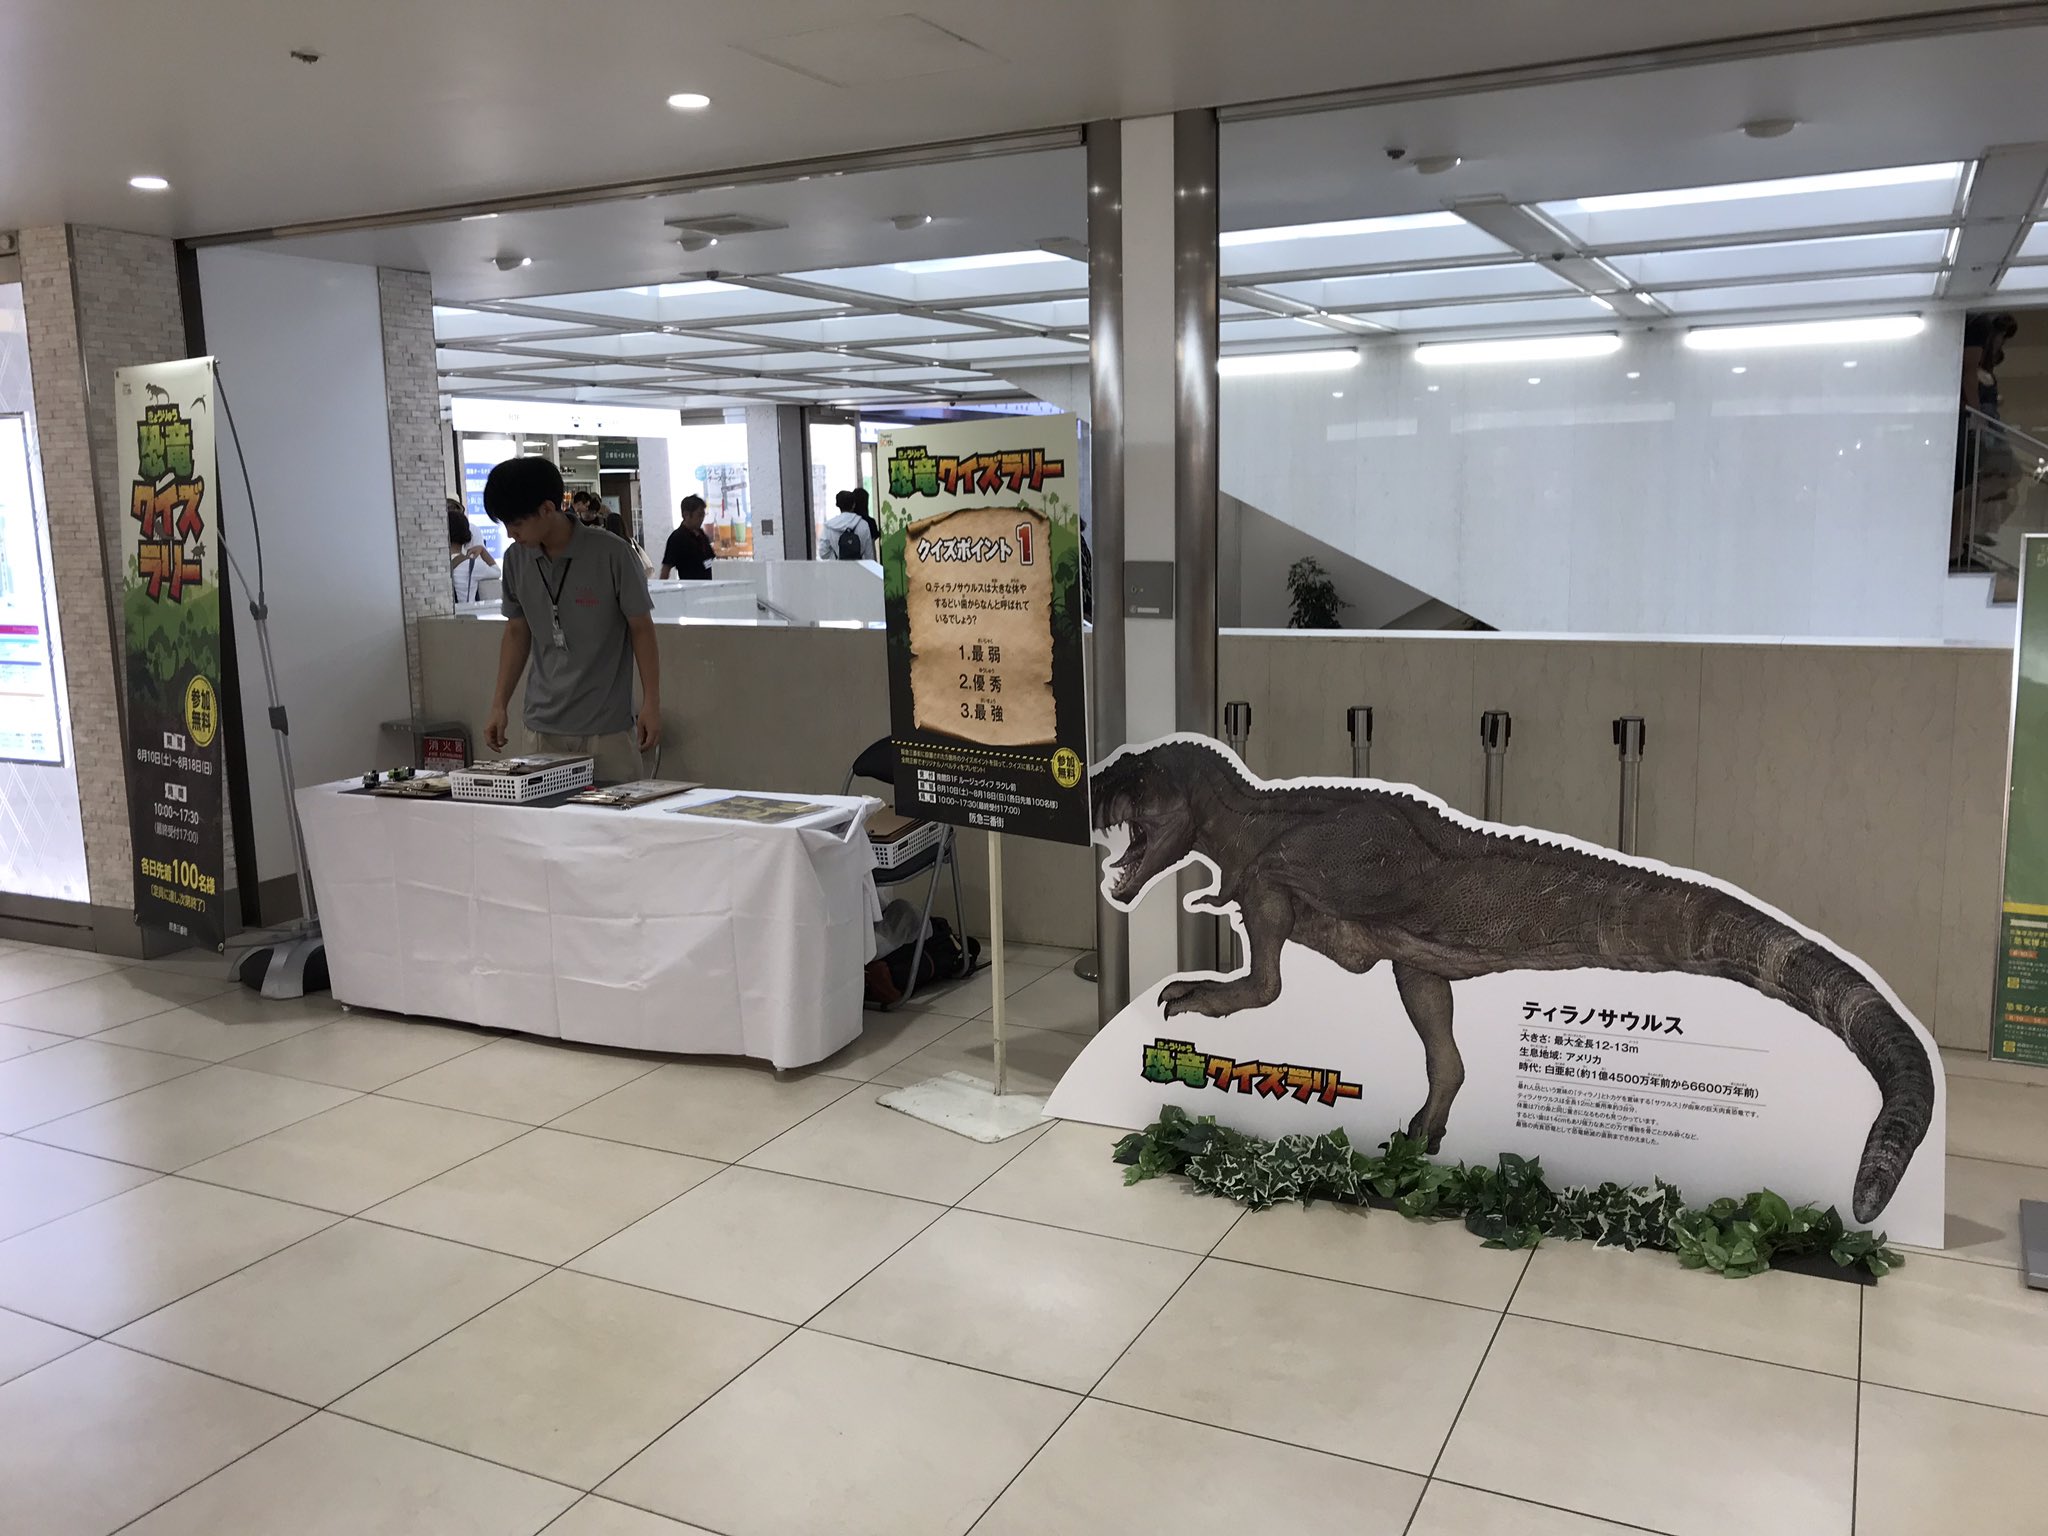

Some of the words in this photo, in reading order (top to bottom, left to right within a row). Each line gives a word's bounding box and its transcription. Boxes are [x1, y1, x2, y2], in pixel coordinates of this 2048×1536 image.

[137, 419, 194, 478] 恐竜
[131, 475, 204, 543] クイズ
[917, 536, 1013, 563] クイズポイント
[1016, 522, 1034, 565] 1
[138, 539, 202, 605] ラリー
[934, 597, 1030, 611] するどい歯からなんと呼ばれて
[191, 688, 211, 711] 参加
[191, 710, 211, 734] 無料
[1057, 754, 1076, 769] 参加
[1057, 766, 1076, 781] 無料
[968, 812, 1005, 829] 阪急三番街
[1522, 1000, 1685, 1035] ティラノサウルス
